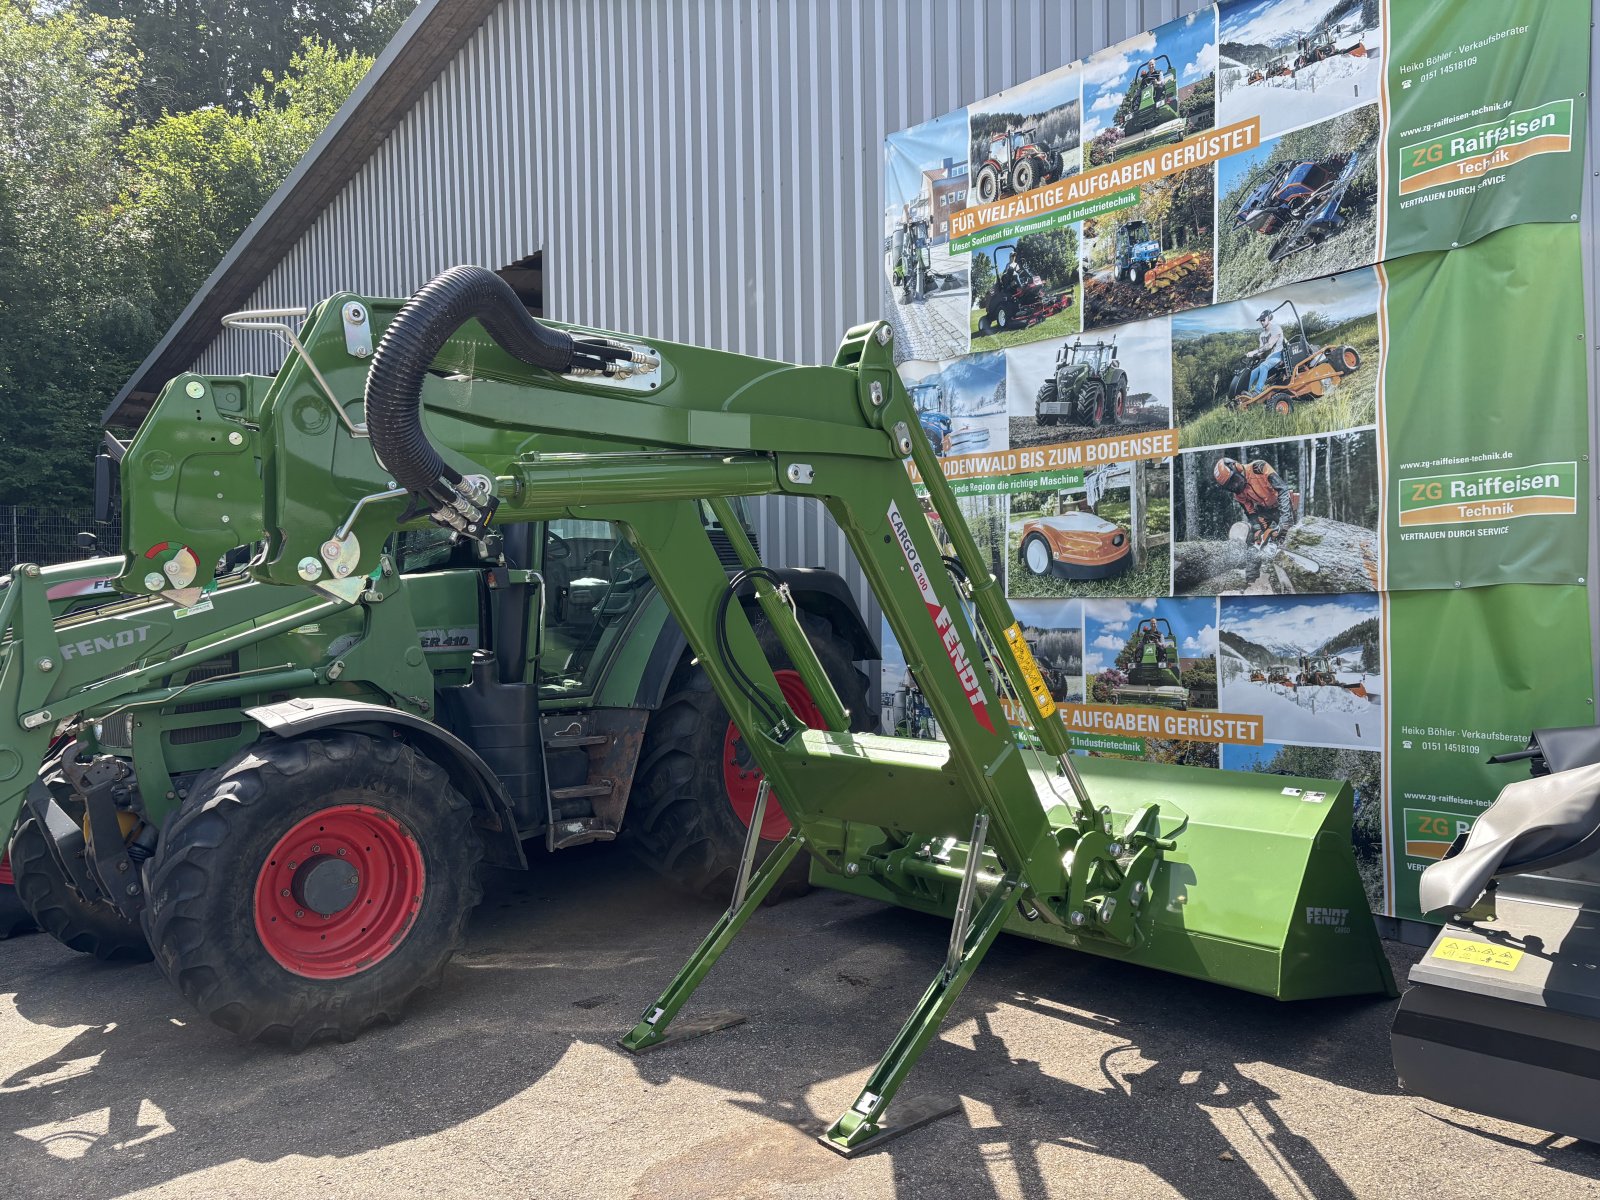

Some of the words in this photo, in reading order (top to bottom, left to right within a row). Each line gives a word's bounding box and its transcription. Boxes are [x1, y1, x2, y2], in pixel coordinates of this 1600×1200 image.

[1400, 62, 1424, 75] Heiko
[1426, 50, 1452, 67] Böhler
[1458, 25, 1529, 54] Verkaufsberater
[1420, 71, 1437, 83] 0151
[1440, 57, 1478, 75] 14518109
[1400, 100, 1512, 138] www.zg-raiffeisen-technik.de
[1412, 144, 1443, 167] ZG
[1450, 113, 1556, 157] Raiffeisen
[952, 212, 975, 234] FÜR
[977, 187, 1064, 225] VIELFÄLTIGE
[1068, 157, 1155, 200] AUFGABEN
[1161, 125, 1256, 171] GERÜSTET
[1400, 192, 1446, 209] VERTRAUEN
[1447, 186, 1476, 199] DURCH
[952, 240, 970, 252] Unser
[972, 228, 1002, 248] Sortiment
[1003, 228, 1013, 238] für
[1015, 217, 1056, 233] Kommunal-
[1058, 212, 1072, 223] und
[1073, 192, 1136, 218] Industrietechnik
[943, 454, 1017, 477] ODENWALD
[1020, 451, 1044, 468] BIS
[1049, 447, 1082, 466] ZUM
[1087, 434, 1173, 463] BODENSEE
[1400, 451, 1513, 470] www.zg-raiffeisen-technik.de
[954, 484, 969, 495] jede
[970, 481, 995, 493] Region
[997, 480, 1009, 490] die
[1010, 476, 1038, 490] richtige
[1040, 474, 1079, 486] Maschine
[1412, 483, 1443, 501] ZG
[1450, 474, 1560, 498] Raiffeisen
[1457, 502, 1514, 518] Technik
[1400, 530, 1446, 541] VERTRAUEN
[1447, 529, 1476, 539] DURCH
[1477, 526, 1509, 537] SERVICE
[890, 511, 917, 561] CARGO
[912, 562, 922, 573] 6
[917, 573, 928, 591] 100
[58, 625, 151, 661] FENDT
[443, 636, 469, 646] 410
[935, 605, 989, 706] FENDT
[1072, 711, 1160, 733] AUFGABEN
[1164, 715, 1259, 740] GERÜSTET
[1401, 726, 1426, 736] Heiko
[1427, 727, 1456, 737] Böhler
[1461, 729, 1531, 743] Verkaufsberater
[1076, 737, 1141, 752] Industrietechnik
[1422, 742, 1441, 751] 0151
[1444, 743, 1480, 754] 14518109
[1418, 815, 1449, 836] ZG
[1306, 907, 1349, 926] FENDT
